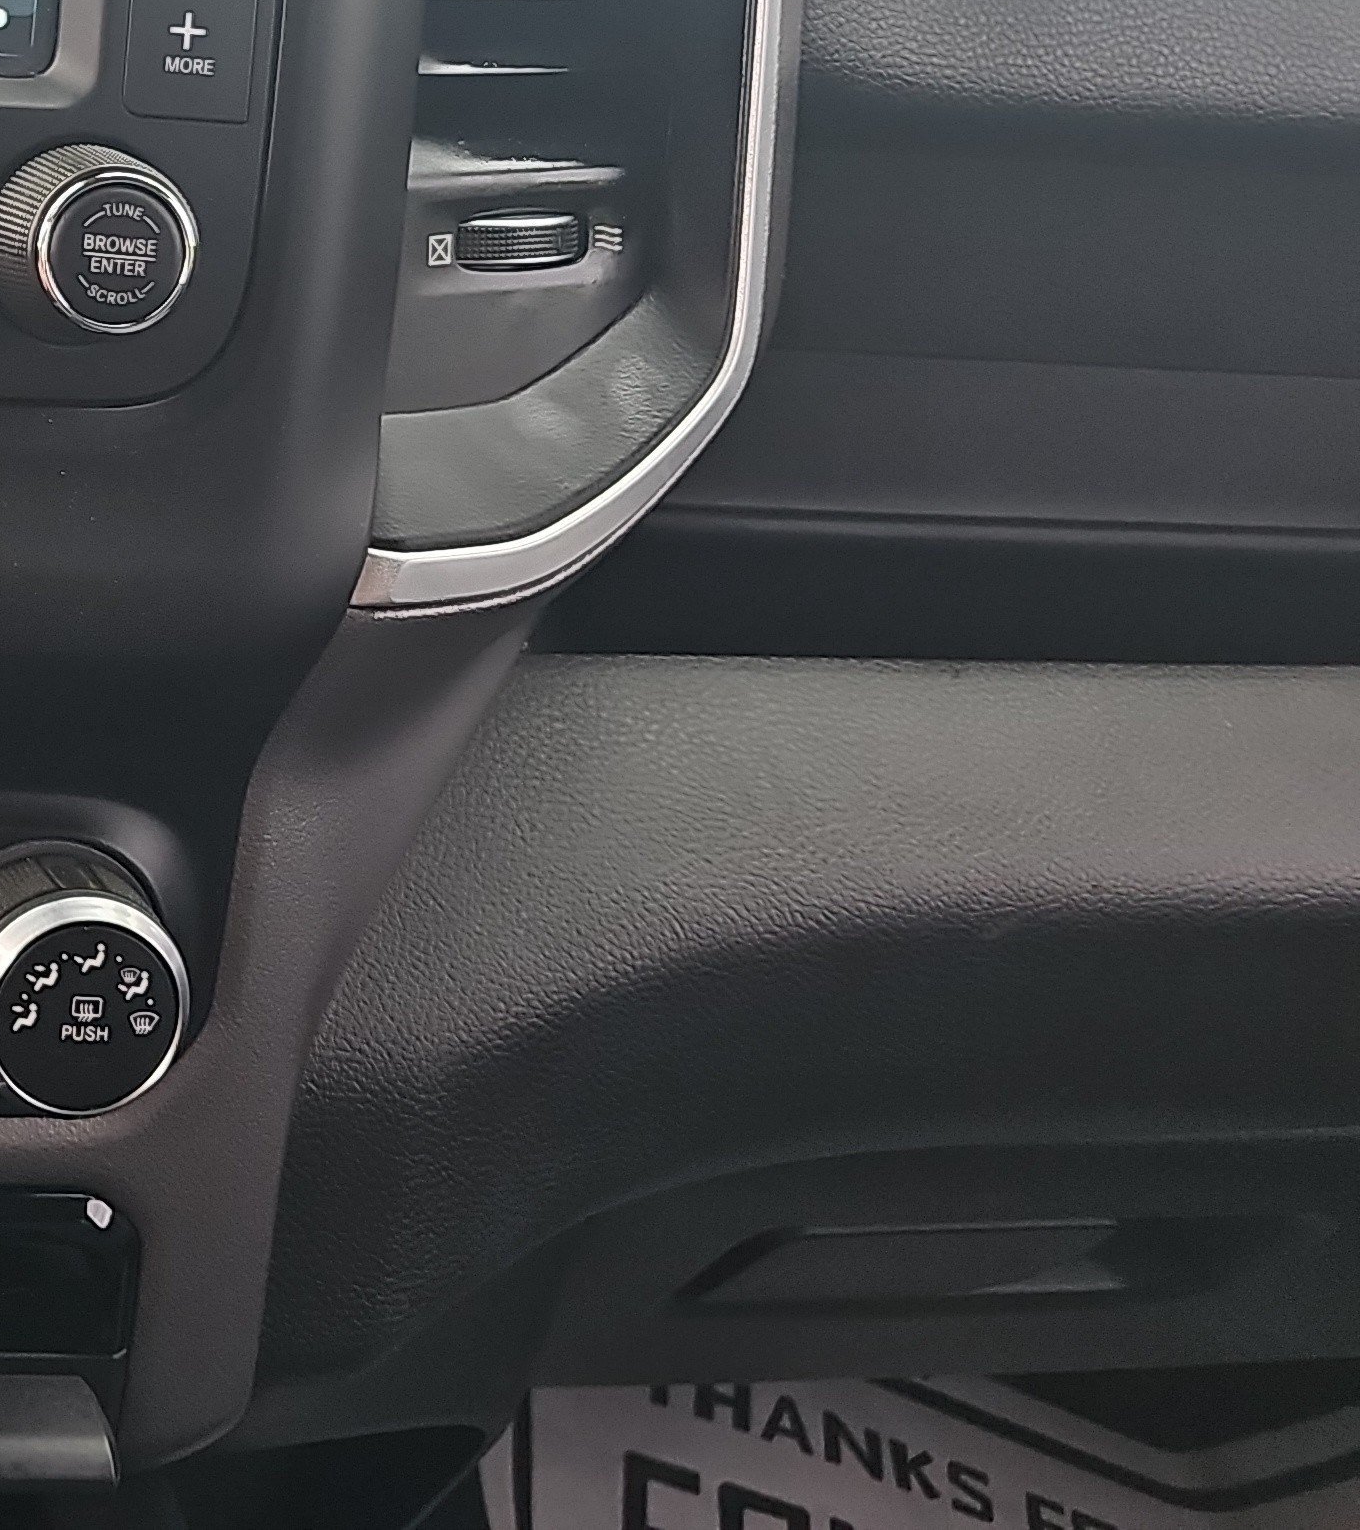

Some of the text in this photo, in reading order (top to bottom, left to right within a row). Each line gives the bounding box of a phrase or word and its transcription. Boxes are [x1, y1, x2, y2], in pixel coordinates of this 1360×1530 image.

[164, 56, 215, 76] MORE
[102, 203, 144, 221] TUNE
[83, 233, 158, 256] BROWSE
[90, 258, 146, 276] ENTER
[86, 285, 145, 305] SCROLL
[60, 1025, 109, 1042] PUSH
